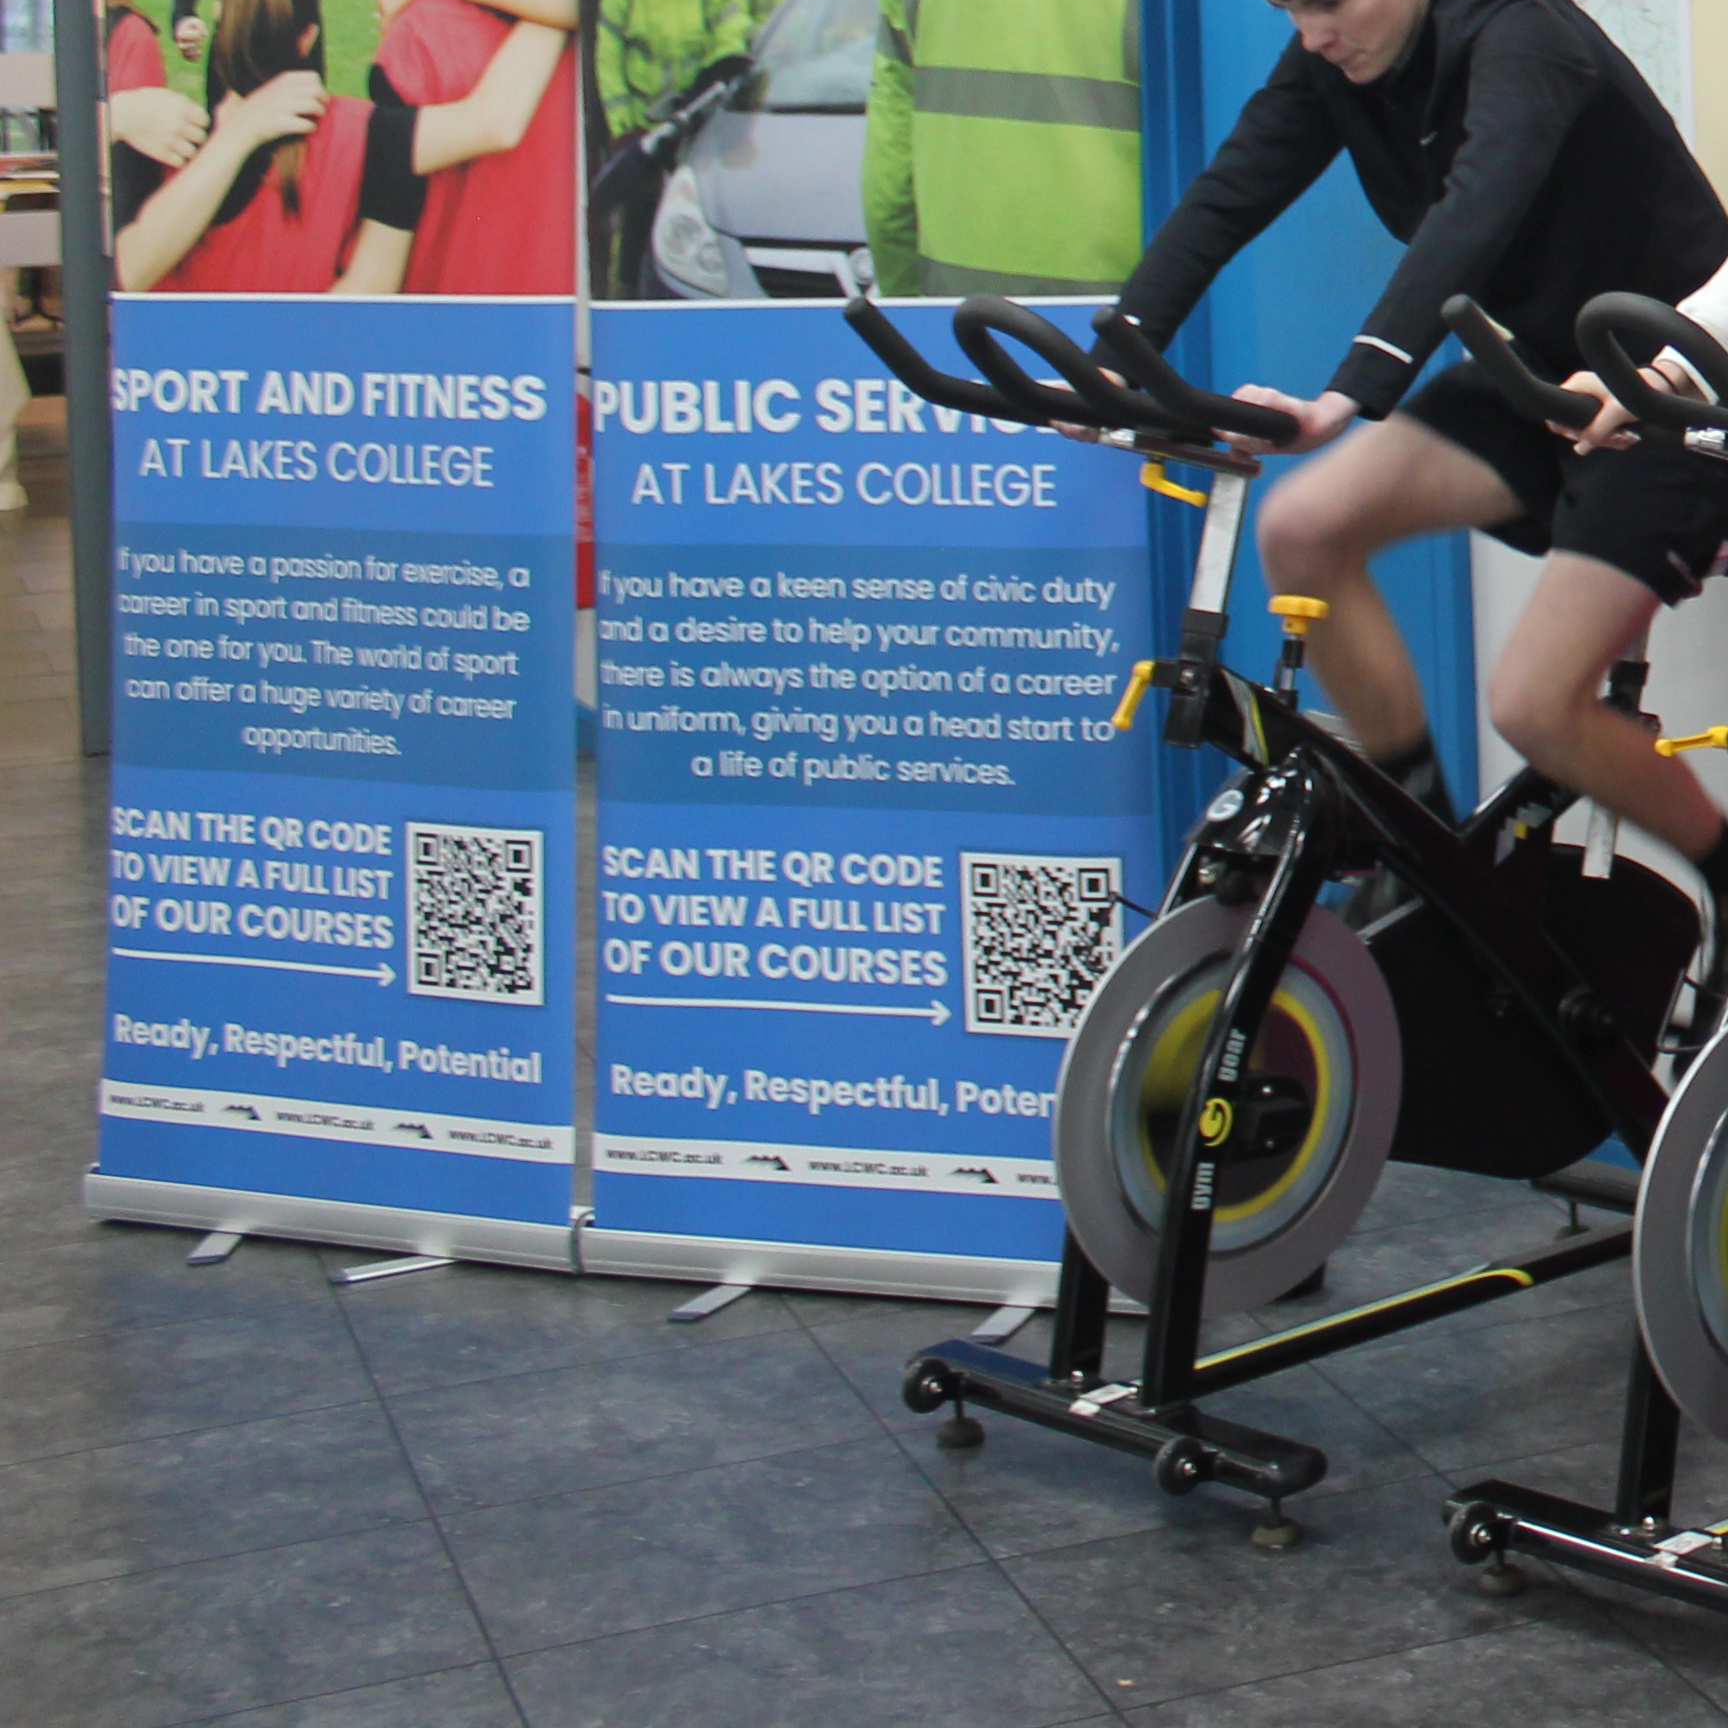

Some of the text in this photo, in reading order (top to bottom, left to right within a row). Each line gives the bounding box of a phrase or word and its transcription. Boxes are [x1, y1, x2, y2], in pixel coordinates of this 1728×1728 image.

[112, 367, 548, 422] SPORT AND FITNESS
[593, 378, 802, 435] PUBLIC
[138, 437, 495, 488] AT LAKES COLLEGE
[631, 461, 691, 505] AT
[704, 461, 845, 506] LAKES
[856, 461, 1057, 507] COLLEGE
[131, 548, 531, 591] you have passion for exercise, a
[613, 571, 1117, 612] you have a keen sense of civic duty
[118, 590, 531, 632] career in sport and fitness could be
[123, 631, 520, 682] the one for you. The world of sport
[600, 615, 1121, 658] and a desire to help your community,
[126, 675, 517, 720] can offer huge variety of career
[600, 659, 1118, 699] there is always the option of a career
[242, 725, 402, 756] opportunities.
[602, 703, 1117, 744] in uniform, giving you head start to
[691, 750, 1016, 786] a life of public services.
[111, 806, 392, 856] SCAN THE QR CODE
[111, 849, 394, 900] TO VIEW A FULL LIST
[602, 845, 944, 889] SCAN THE QR CODE
[112, 893, 396, 950] OF OUR COURSES
[602, 891, 946, 935] TO VIEW A FULL LIST
[603, 938, 949, 988] OF OUR COURSES
[113, 1012, 543, 1084] Ready, Respectful, Potential
[610, 1063, 950, 1117] Ready, Respectful,
